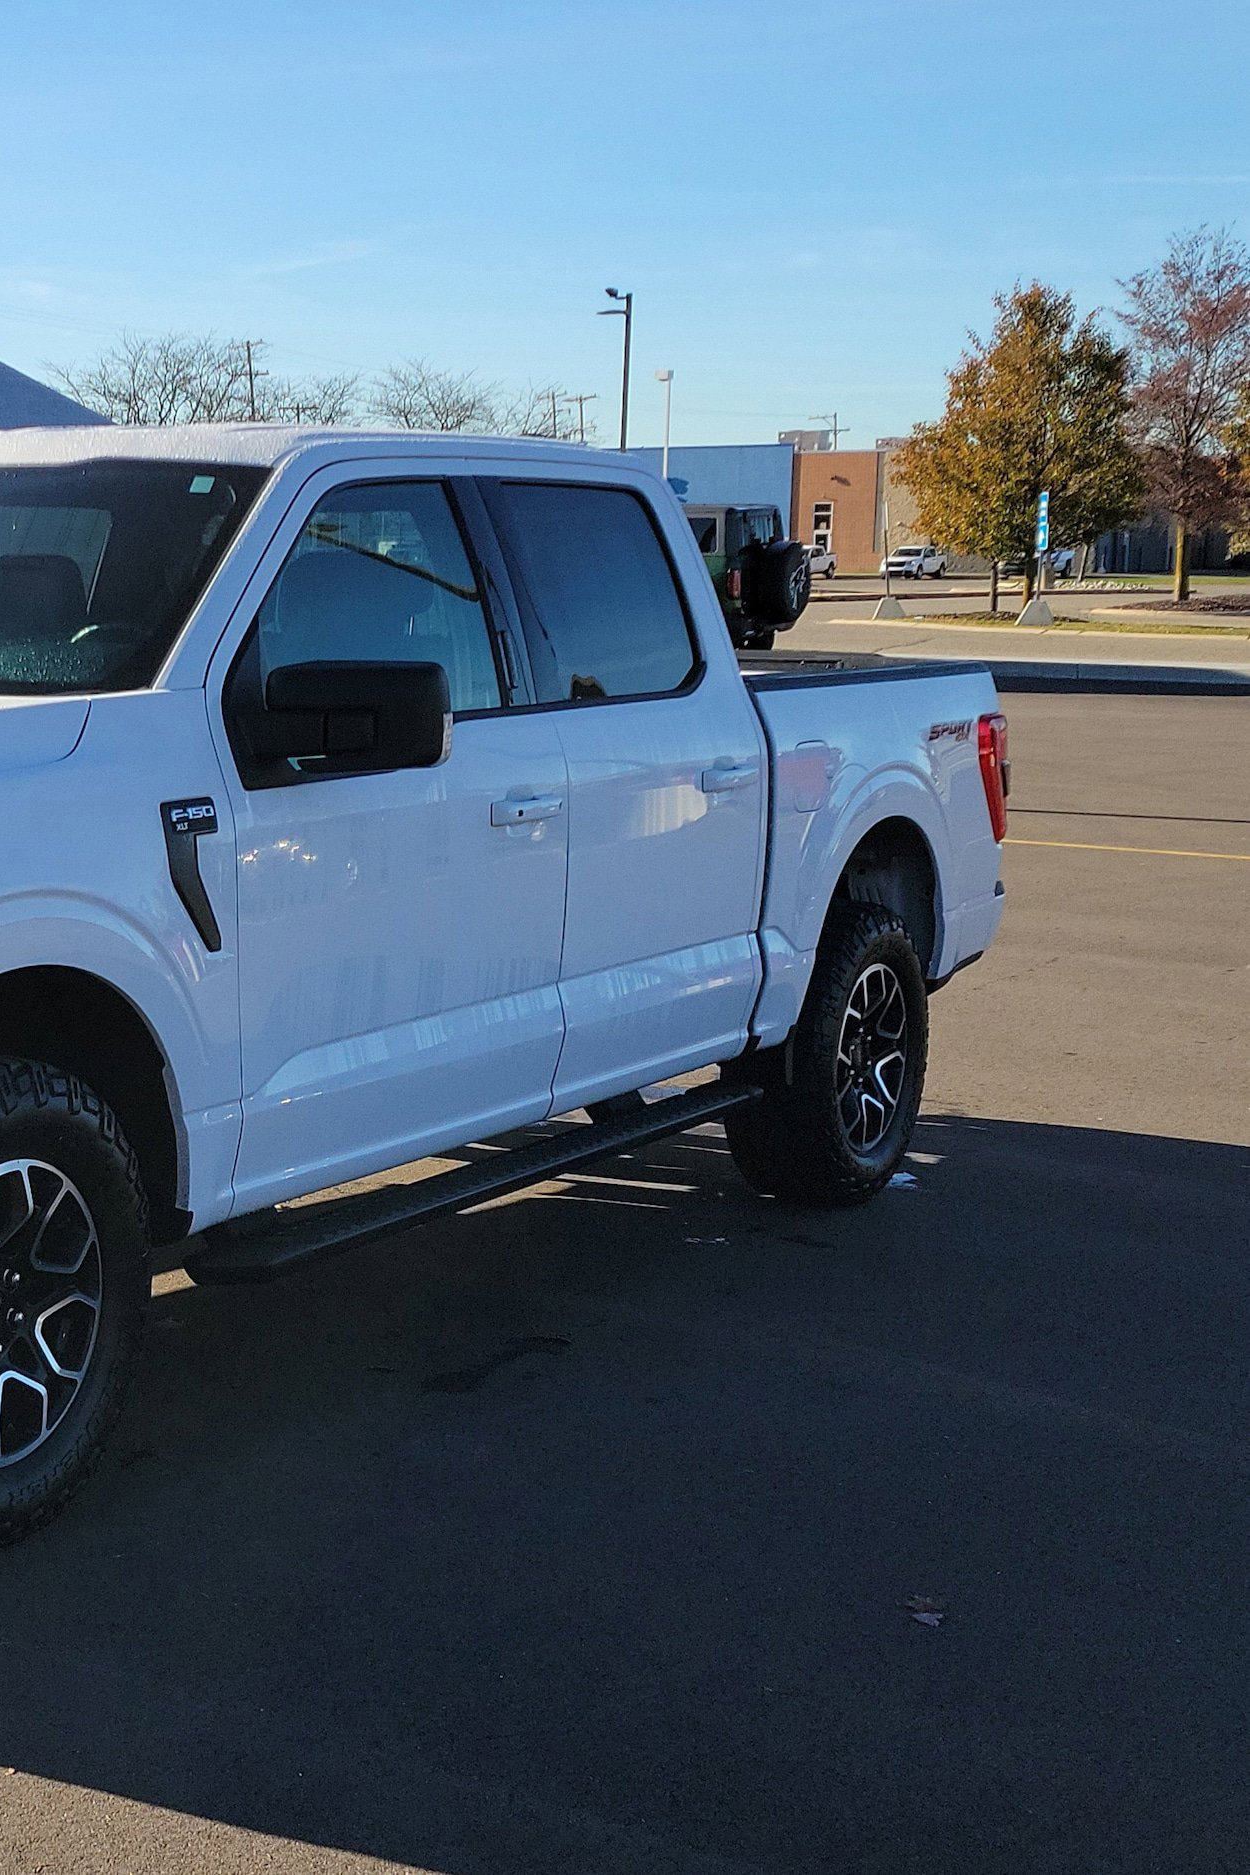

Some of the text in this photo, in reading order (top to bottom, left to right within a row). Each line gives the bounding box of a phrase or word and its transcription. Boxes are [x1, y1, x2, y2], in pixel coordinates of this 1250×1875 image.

[928, 719, 974, 741] SPORT
[171, 805, 215, 822] F-150
[176, 822, 189, 831] XLT
